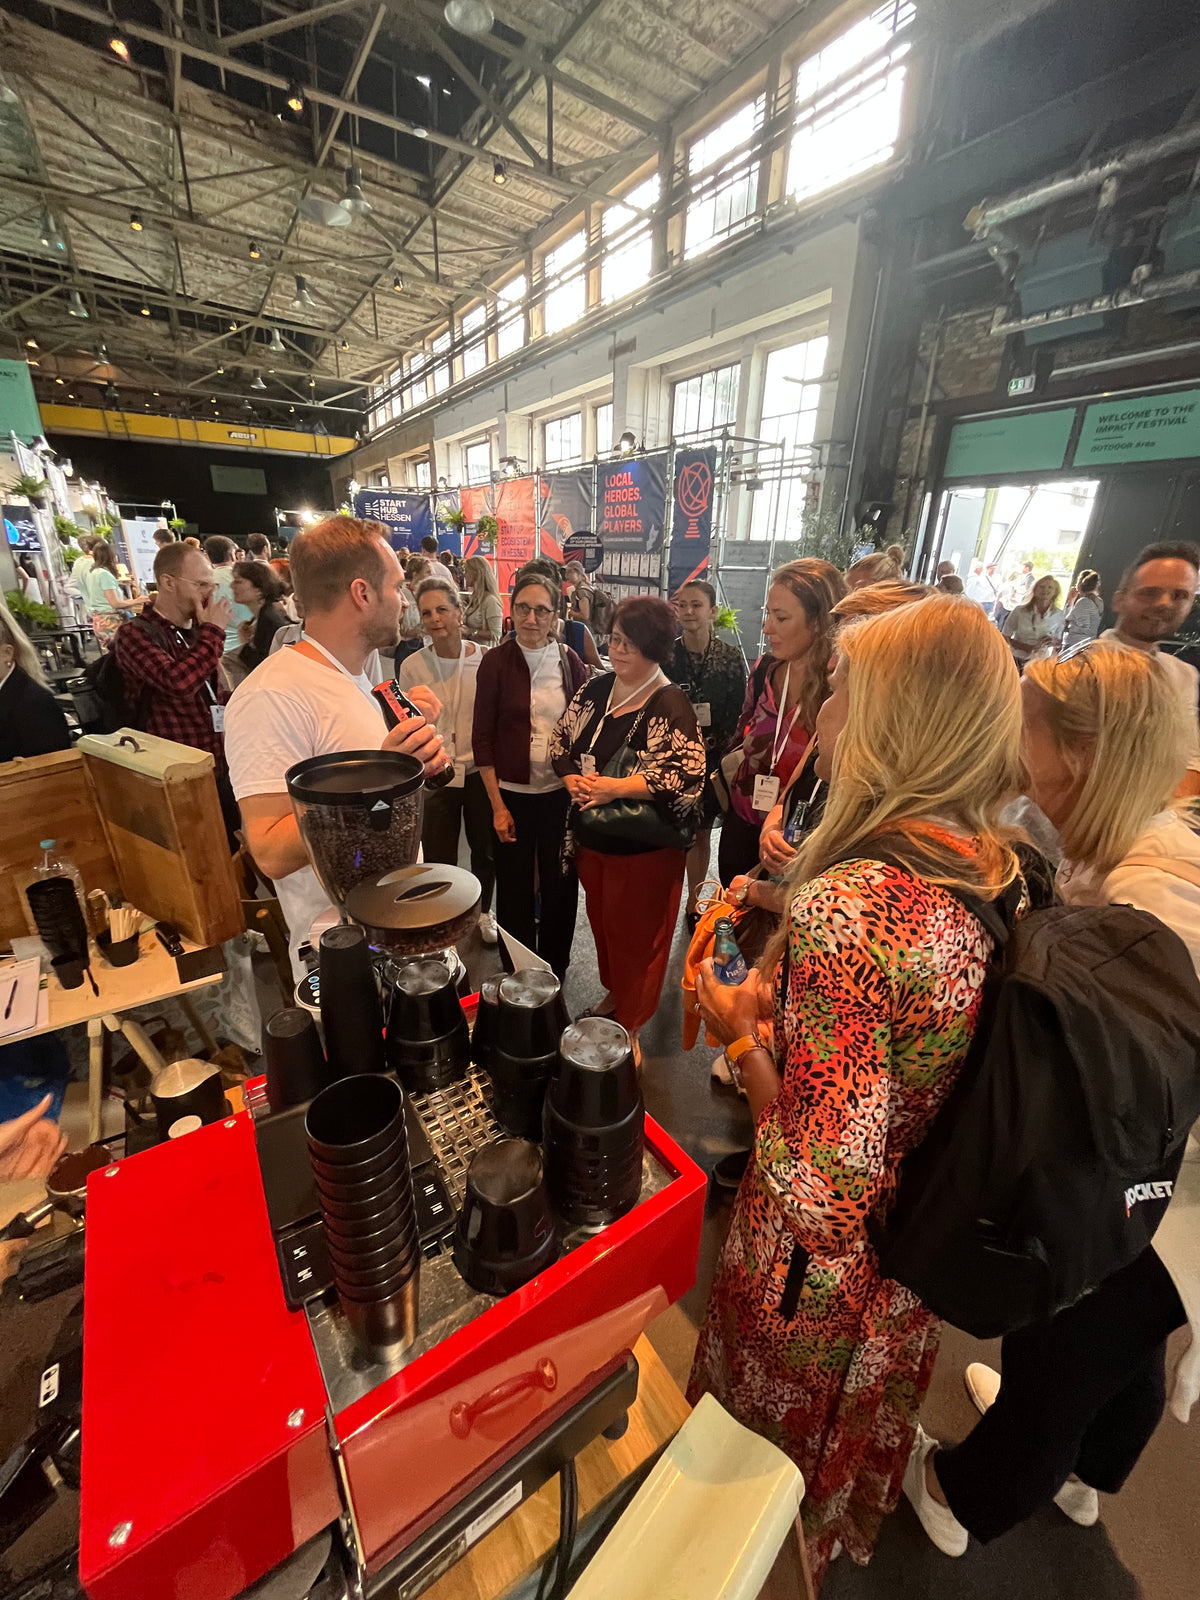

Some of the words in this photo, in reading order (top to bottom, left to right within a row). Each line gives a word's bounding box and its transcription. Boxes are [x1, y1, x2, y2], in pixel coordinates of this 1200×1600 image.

[1099, 409, 1151, 424] WELCOME
[1154, 407, 1169, 417] TO
[1173, 403, 1196, 414] THE
[1095, 422, 1135, 434] IMPACT
[1136, 417, 1188, 430] FESTIVAL
[1090, 442, 1133, 453] OUTDOOR
[604, 471, 634, 488] LOCAL
[604, 487, 642, 503] HEROES.
[379, 499, 407, 508] START
[603, 503, 639, 518] GLOBAL
[380, 513, 412, 522] HESSEN
[603, 519, 645, 533] PLAYERS.
